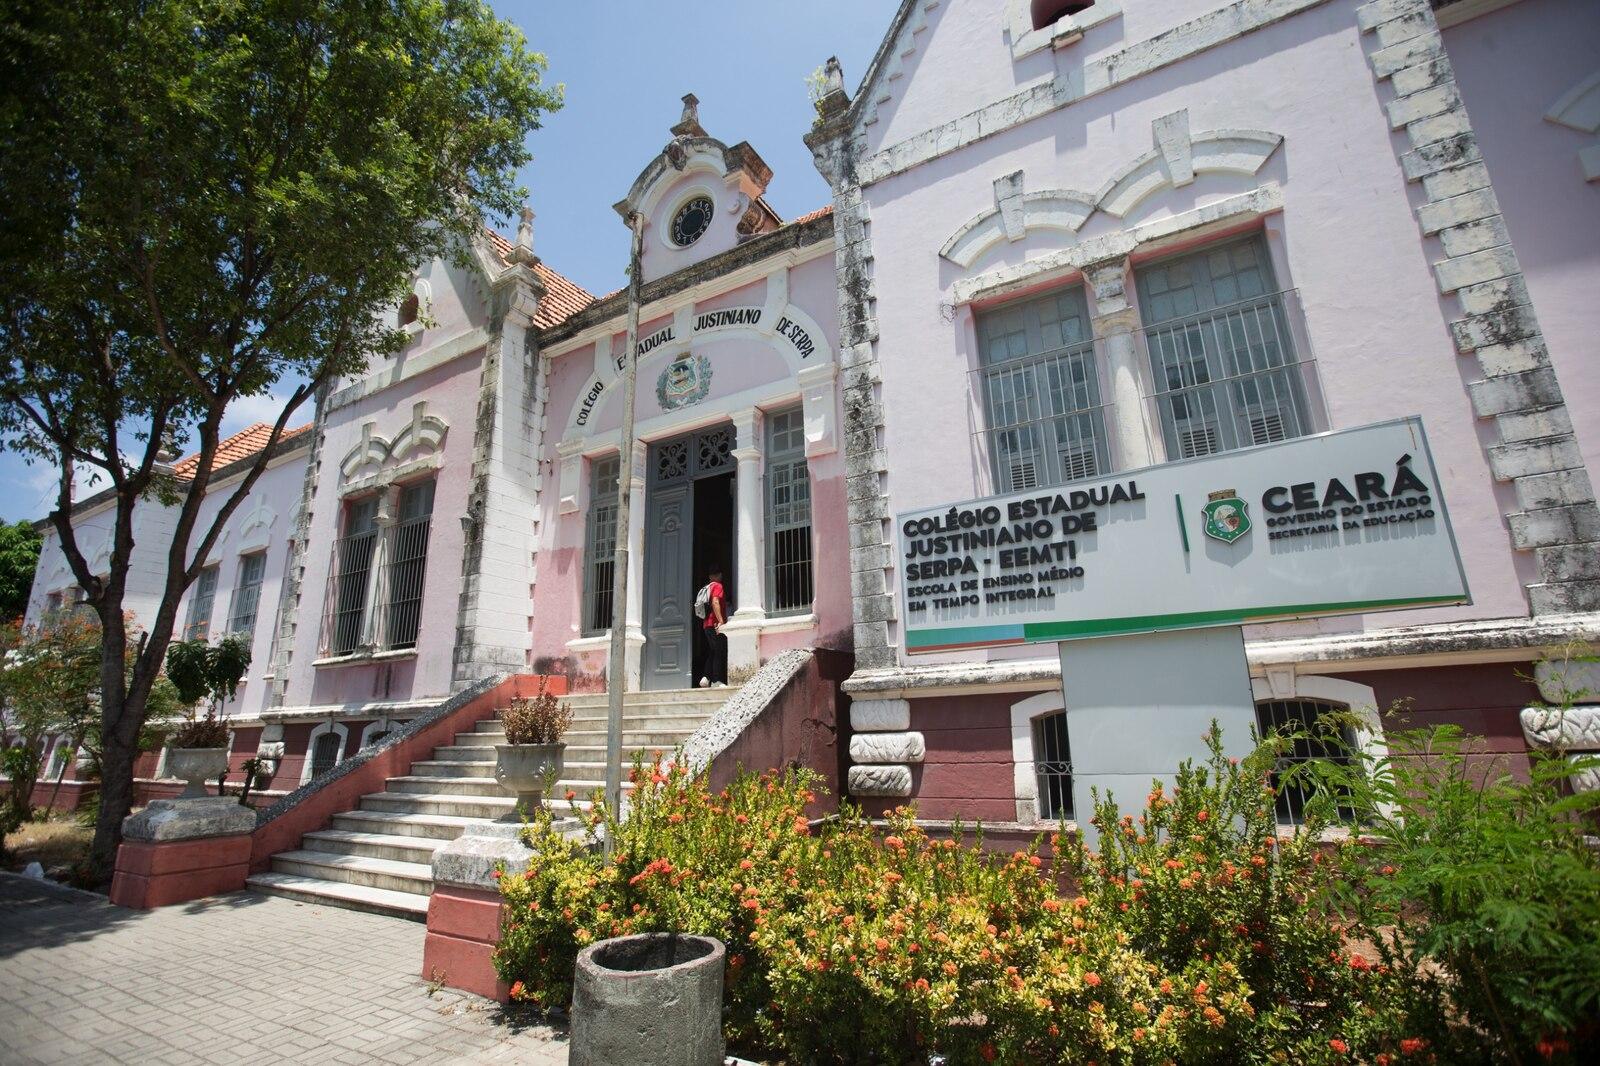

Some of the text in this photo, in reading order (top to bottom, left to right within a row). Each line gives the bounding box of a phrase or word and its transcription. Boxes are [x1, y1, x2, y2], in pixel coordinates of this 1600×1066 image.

[616, 328, 675, 370] EADUAL
[694, 309, 761, 331] JUSTINIANO
[776, 316, 793, 334] DE
[788, 324, 814, 358] SERPA
[1262, 453, 1428, 513] CEARÁ
[903, 480, 1146, 538] COLÉGIO ESTADUAL
[1266, 495, 1431, 527] GOVERNO DO ESTADO
[1268, 509, 1435, 540] SECRETARIA DA EDUCAÇÃO
[906, 512, 1097, 558] JUSTINIANO DE
[906, 556, 978, 582] SERPA
[999, 540, 1076, 569] EEMTI
[908, 566, 1084, 598] ESCOLA DE ENSINO MÉDIO
[908, 586, 1055, 612] EM TEMPO INTEGRAL
